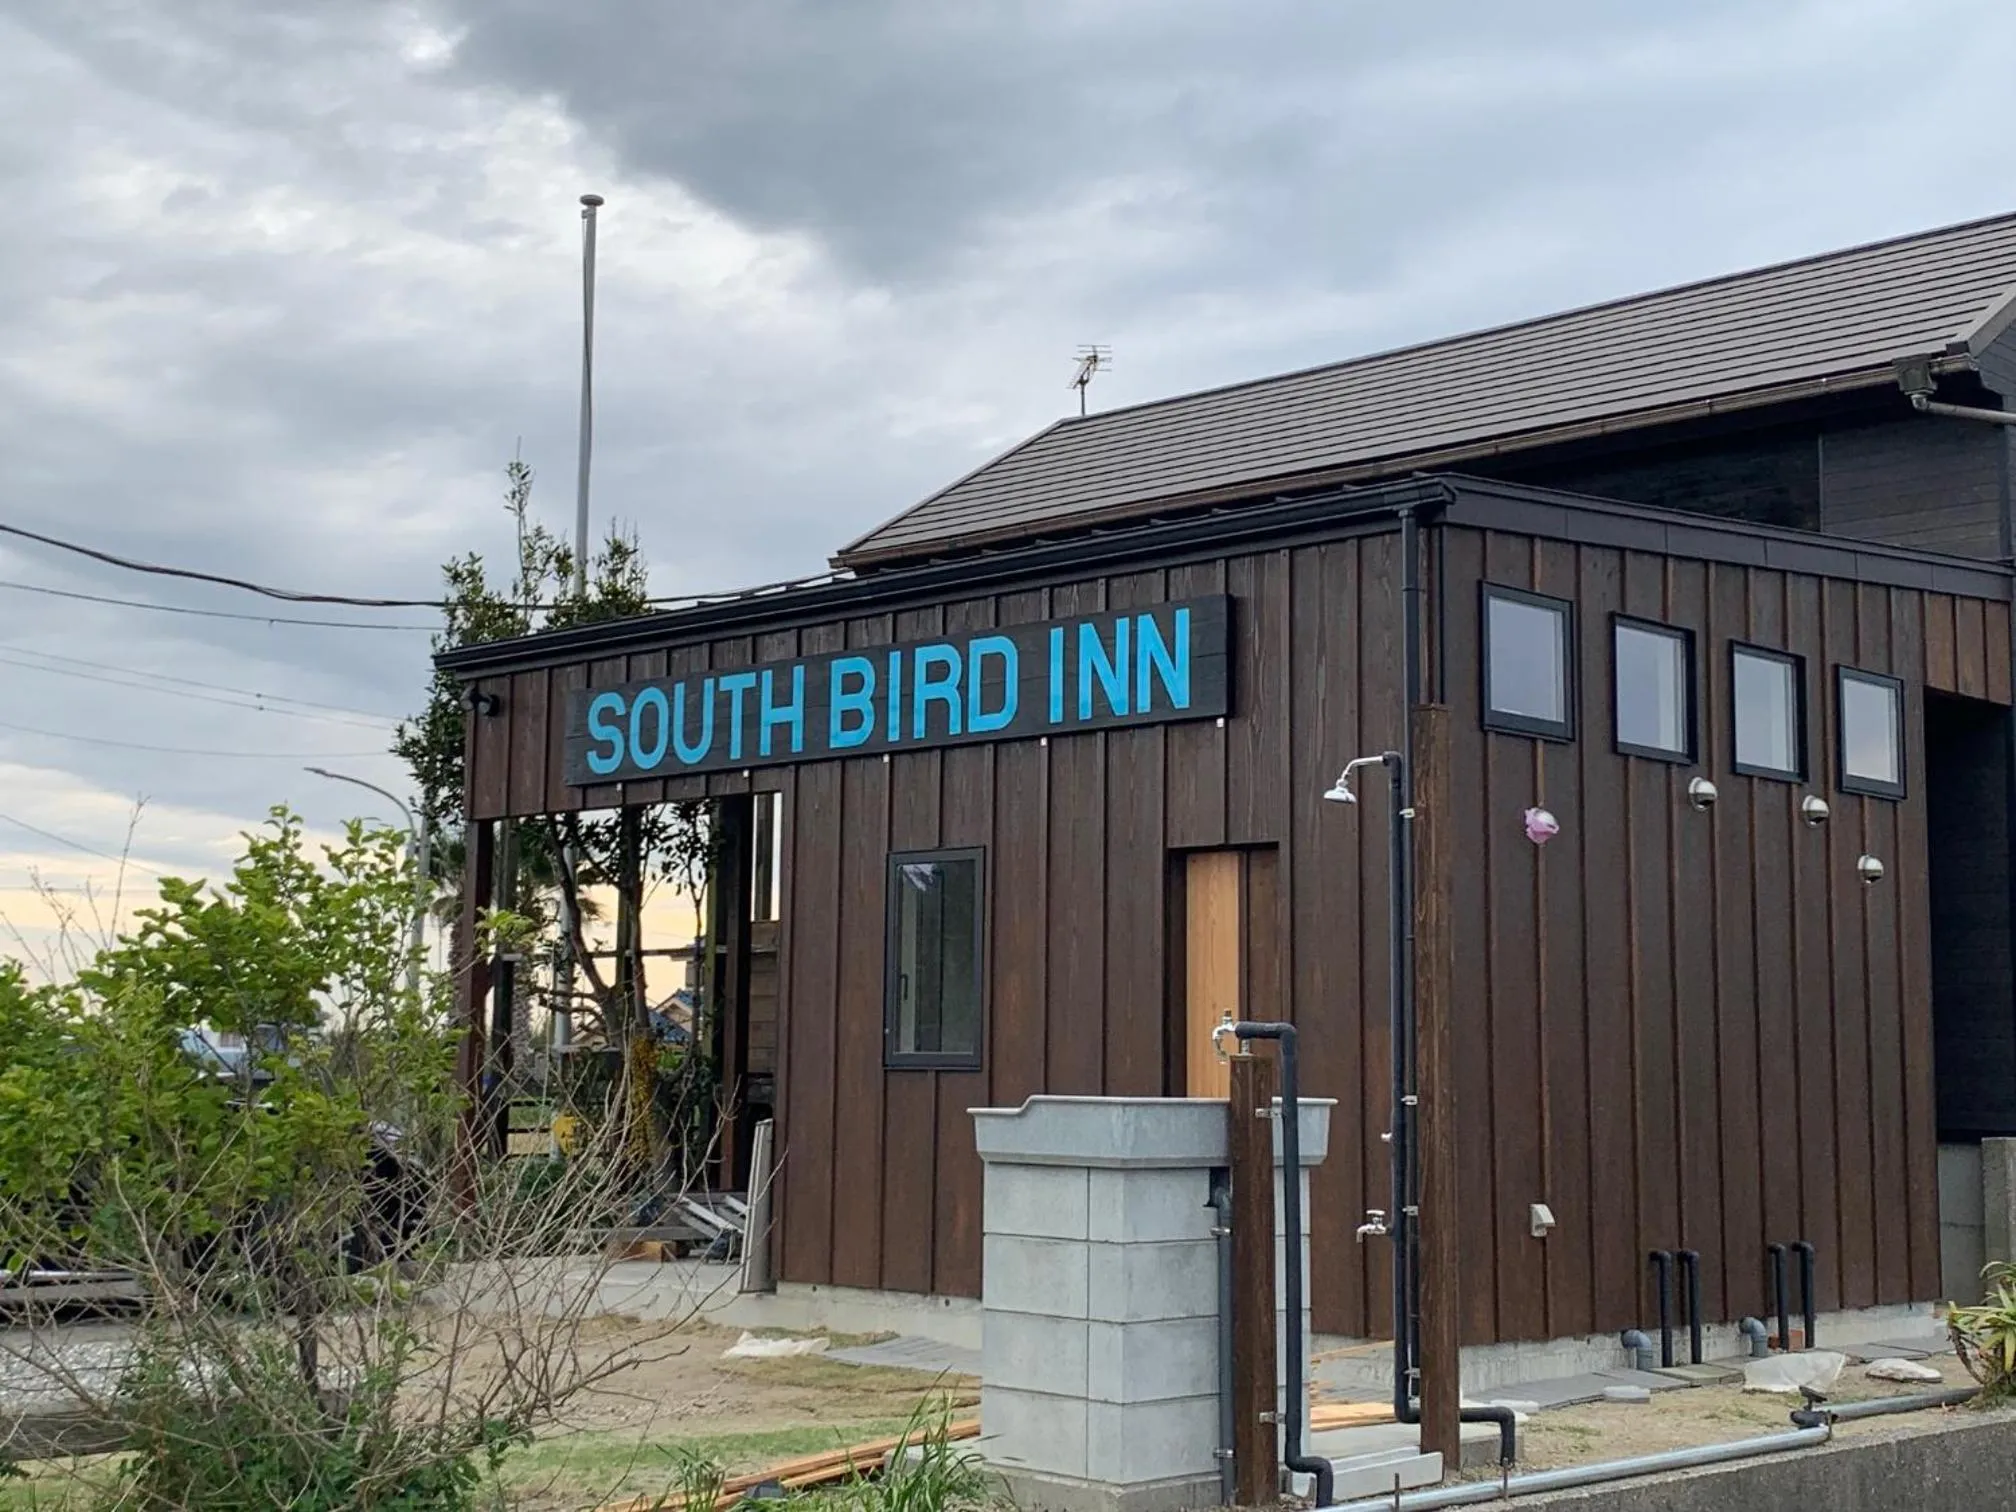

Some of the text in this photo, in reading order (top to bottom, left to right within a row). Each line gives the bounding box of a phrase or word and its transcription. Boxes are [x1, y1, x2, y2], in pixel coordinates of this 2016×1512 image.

[586, 607, 1191, 775] SOUTH BIRD INN
